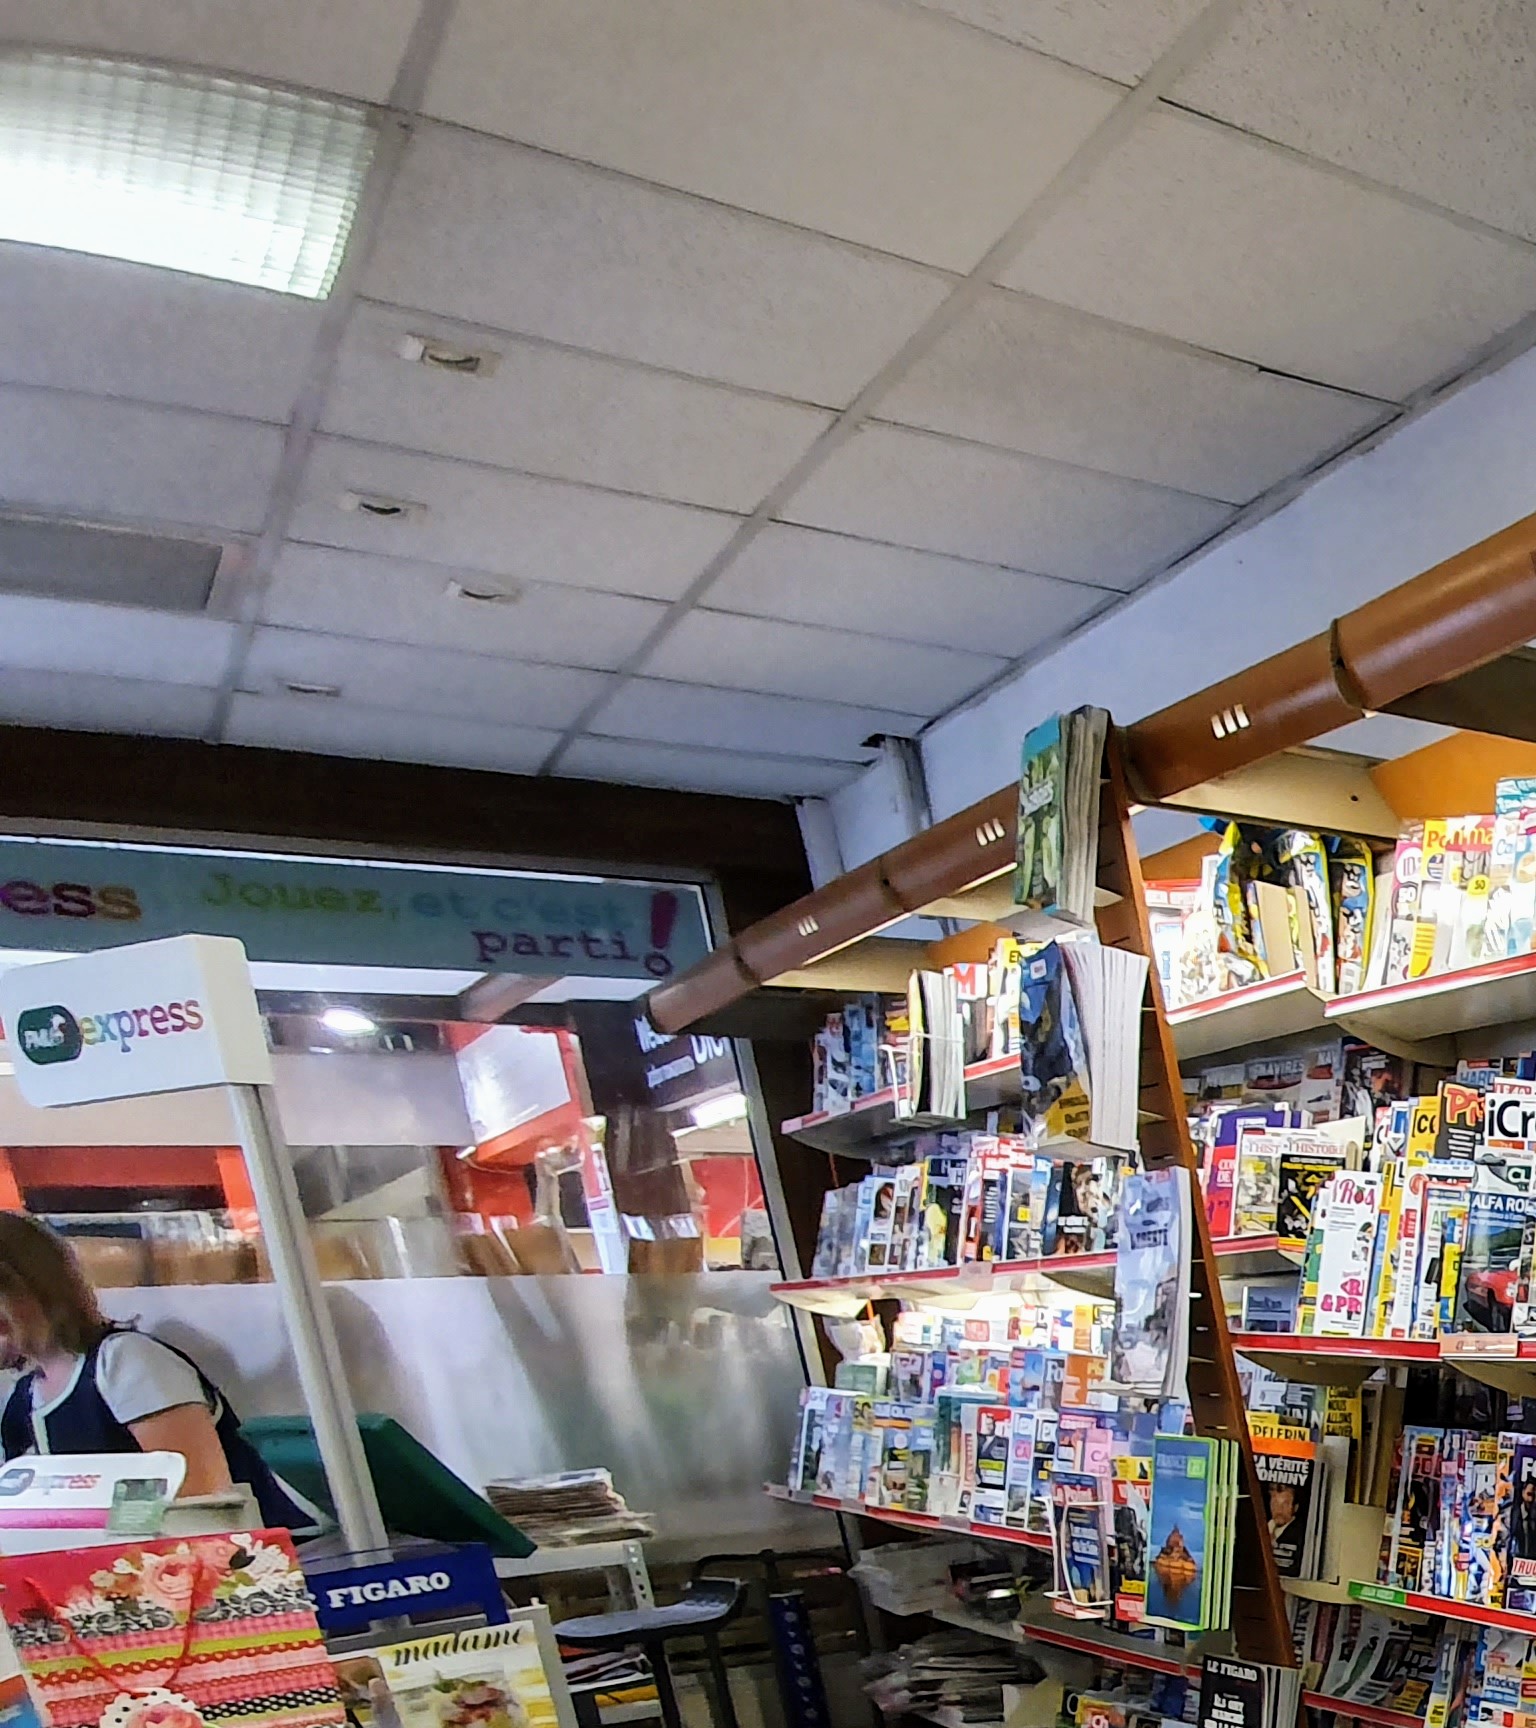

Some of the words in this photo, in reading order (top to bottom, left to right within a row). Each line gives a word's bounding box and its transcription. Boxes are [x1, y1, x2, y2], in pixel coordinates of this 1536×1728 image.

[80, 999, 204, 1053] express
[1268, 1456, 1310, 1473] VÉRITÉ
[326, 1570, 452, 1610] FIGARO
[391, 1624, 526, 1669] madame
[1206, 1659, 1220, 1673] LE
[1221, 1662, 1259, 1682] FIGARO
